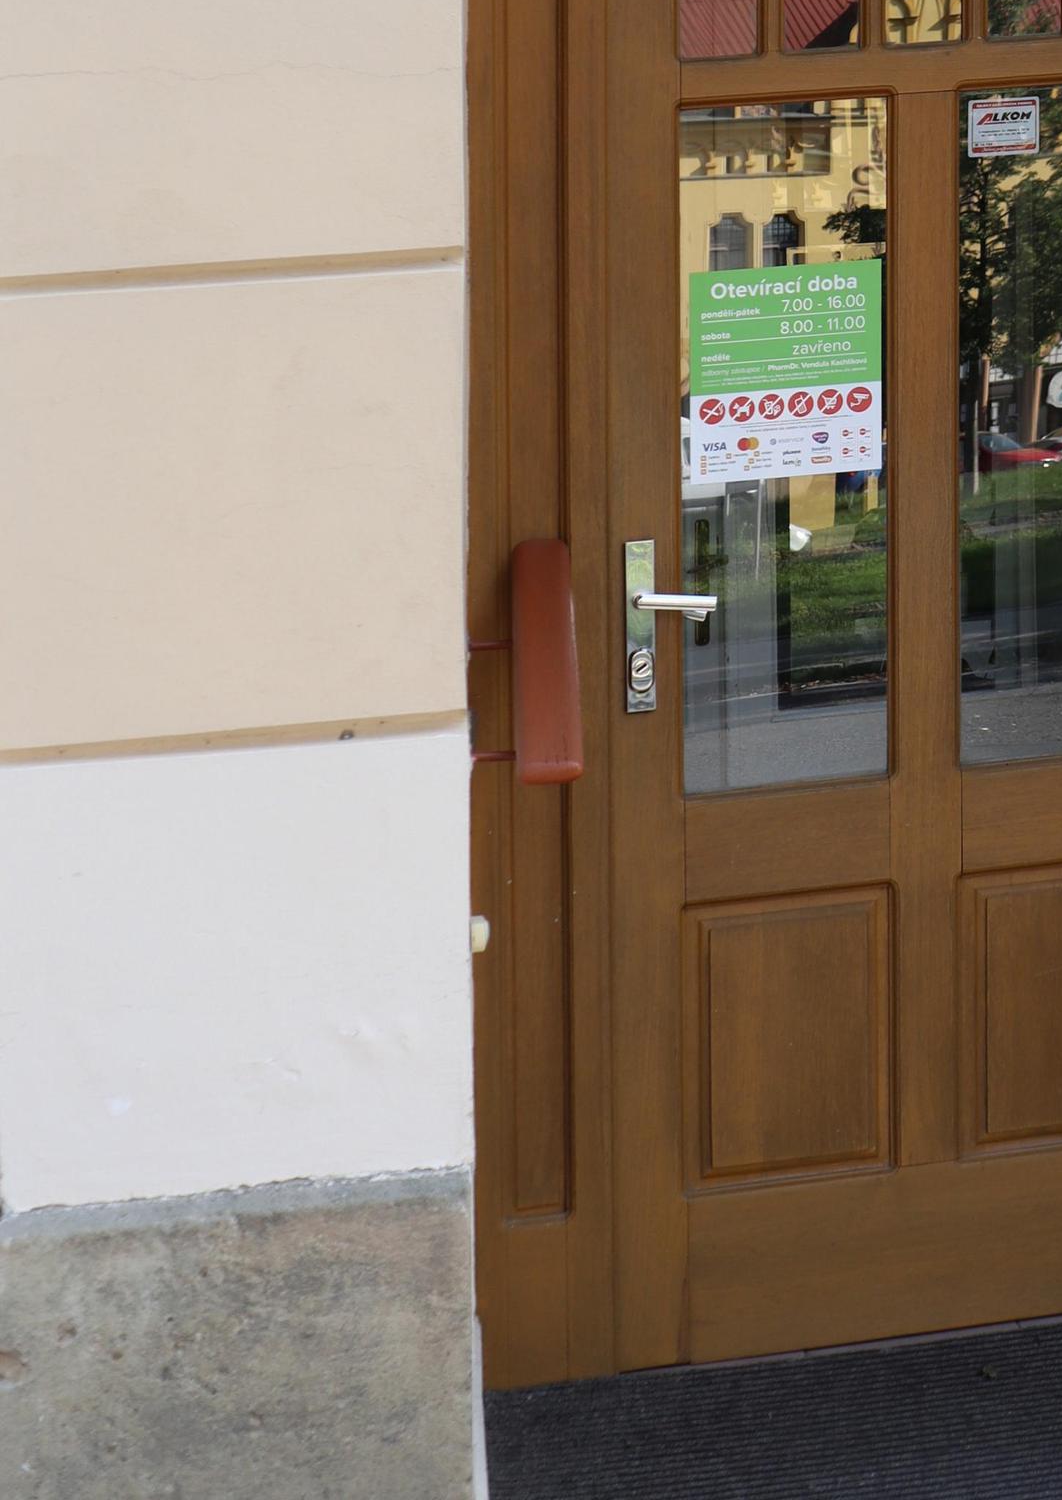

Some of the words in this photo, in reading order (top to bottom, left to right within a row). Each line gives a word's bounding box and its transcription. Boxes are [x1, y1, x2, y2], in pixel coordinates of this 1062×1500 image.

[976, 111, 1032, 125] ALKOM
[710, 277, 802, 300] Otevírací
[807, 274, 858, 293] doba
[781, 298, 813, 313] 7.00
[827, 293, 865, 310] 16.00
[780, 319, 814, 335] 8.00
[827, 315, 865, 331] 11.00
[701, 332, 731, 341] sobota
[792, 340, 851, 356] zavřeno
[701, 353, 731, 363] neděle
[703, 442, 727, 452] VISA
